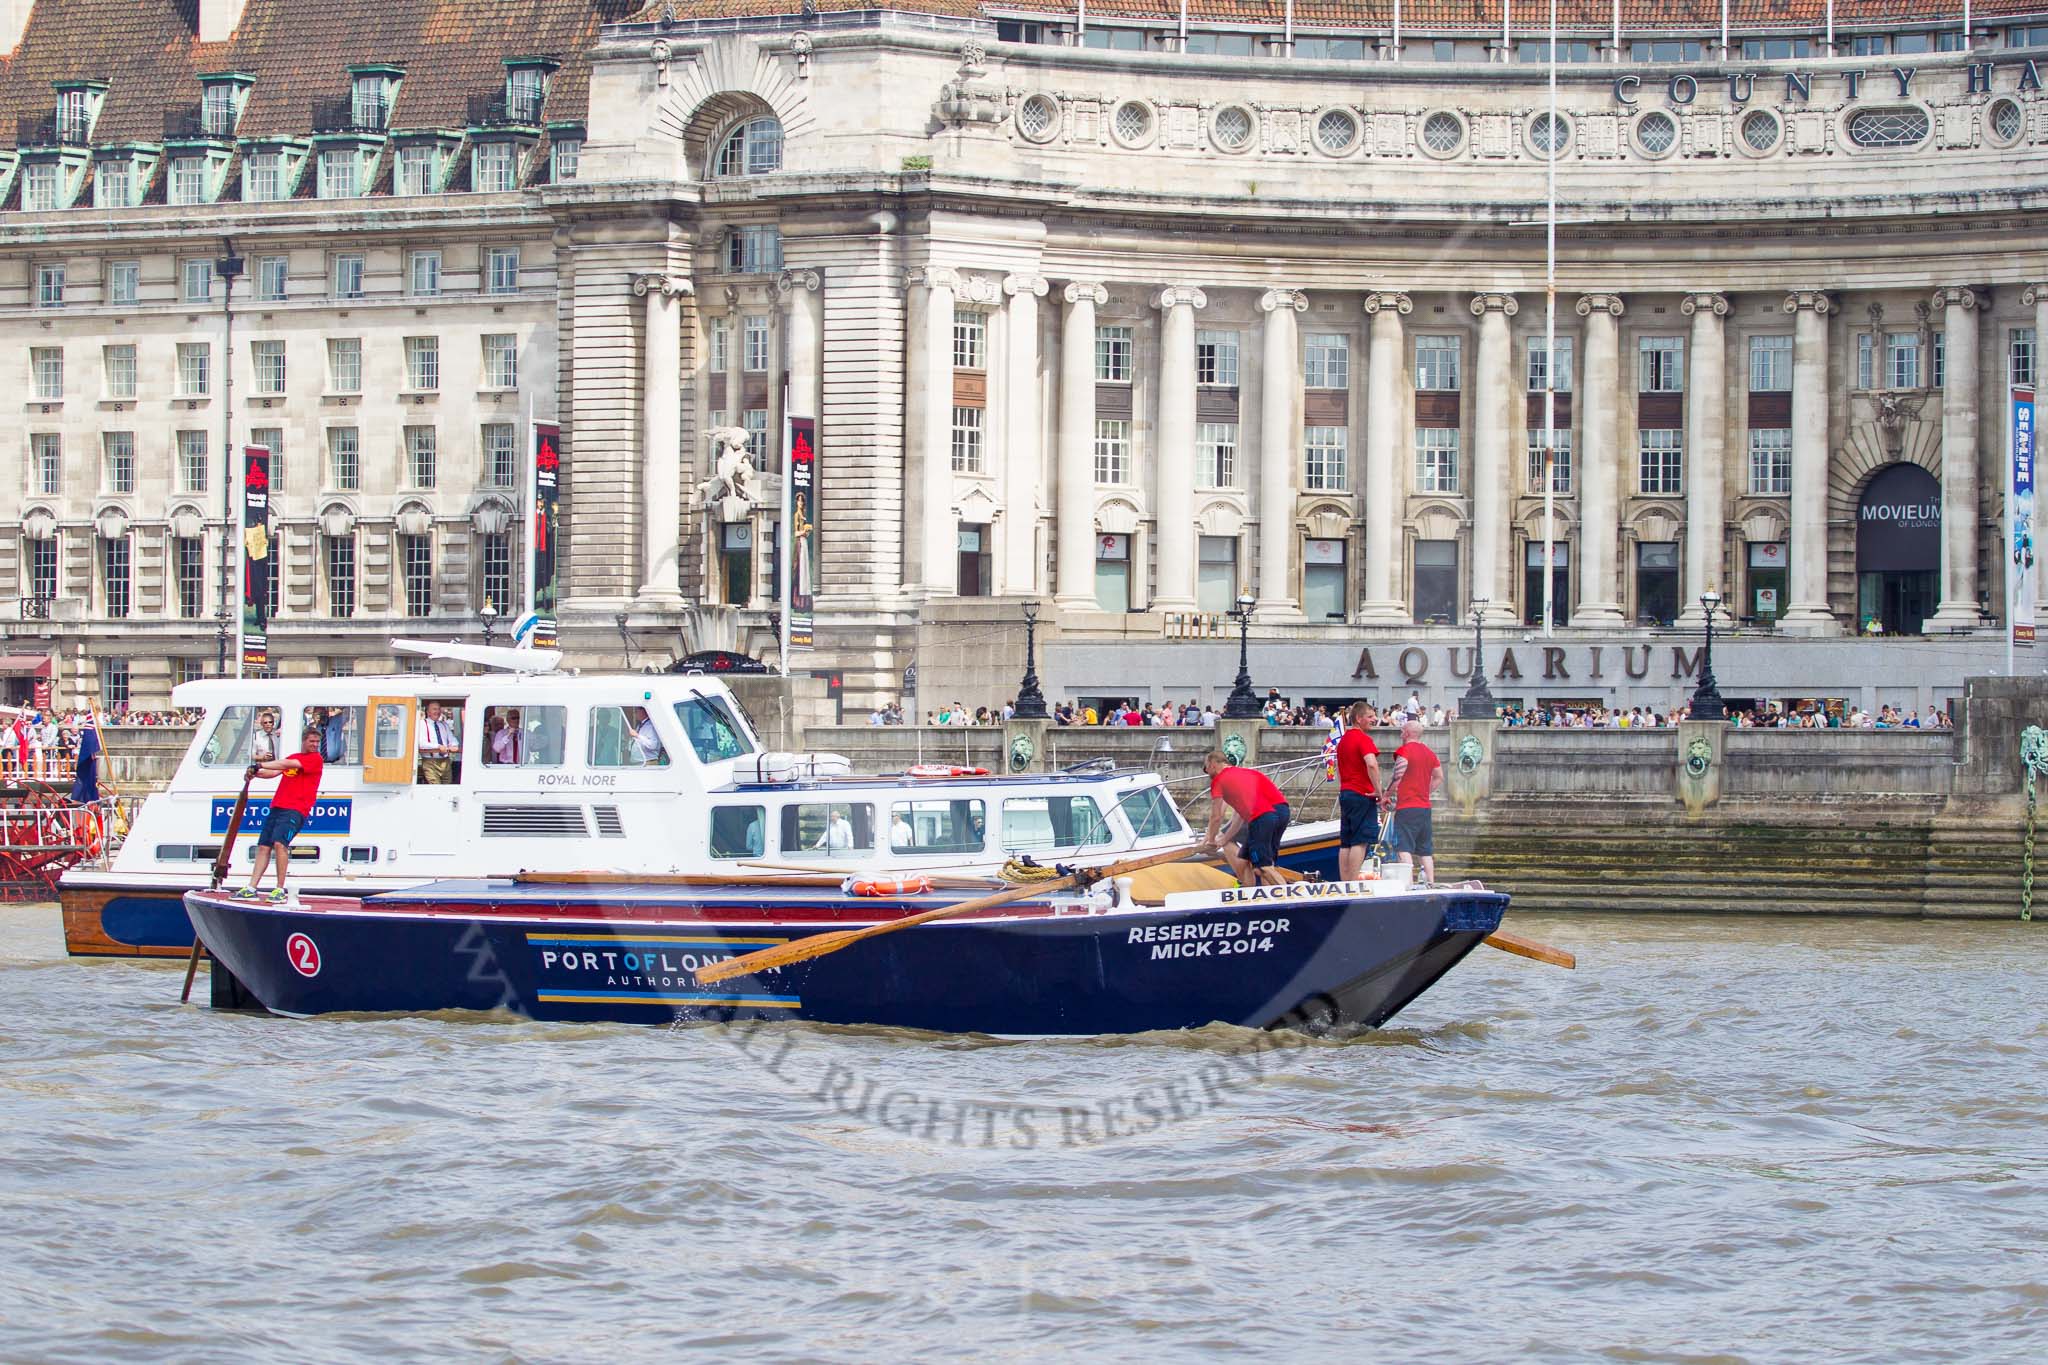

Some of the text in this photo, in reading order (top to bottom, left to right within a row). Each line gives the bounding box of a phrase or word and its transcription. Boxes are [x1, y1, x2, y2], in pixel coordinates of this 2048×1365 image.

[1613, 67, 1918, 105] COUNTY
[1862, 505, 1941, 519] MOVIEUM
[1351, 646, 1707, 684] AQUARIUM
[538, 774, 616, 786] ROYAL NORE
[1221, 882, 1373, 904] BLACKWALL
[1128, 918, 1291, 944] RESERVED FOR
[296, 940, 314, 969] 2
[1151, 937, 1275, 960] MICK 2014
